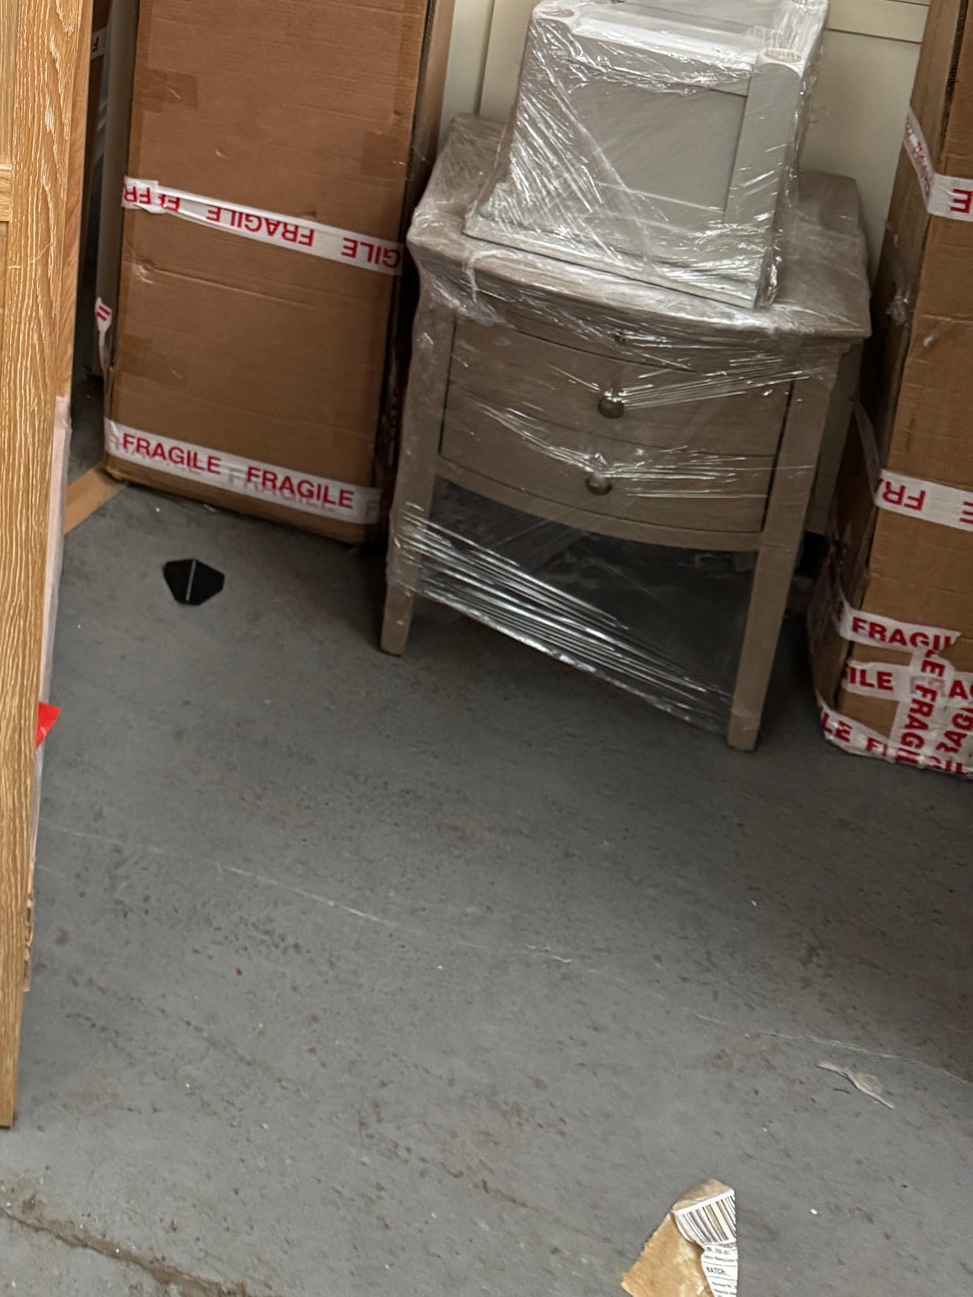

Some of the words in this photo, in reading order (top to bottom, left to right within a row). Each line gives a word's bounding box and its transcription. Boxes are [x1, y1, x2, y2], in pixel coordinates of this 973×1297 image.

[206, 205, 315, 247] FRAGILE
[122, 432, 222, 475] FRAGILE
[246, 465, 355, 510] FRAGILE
